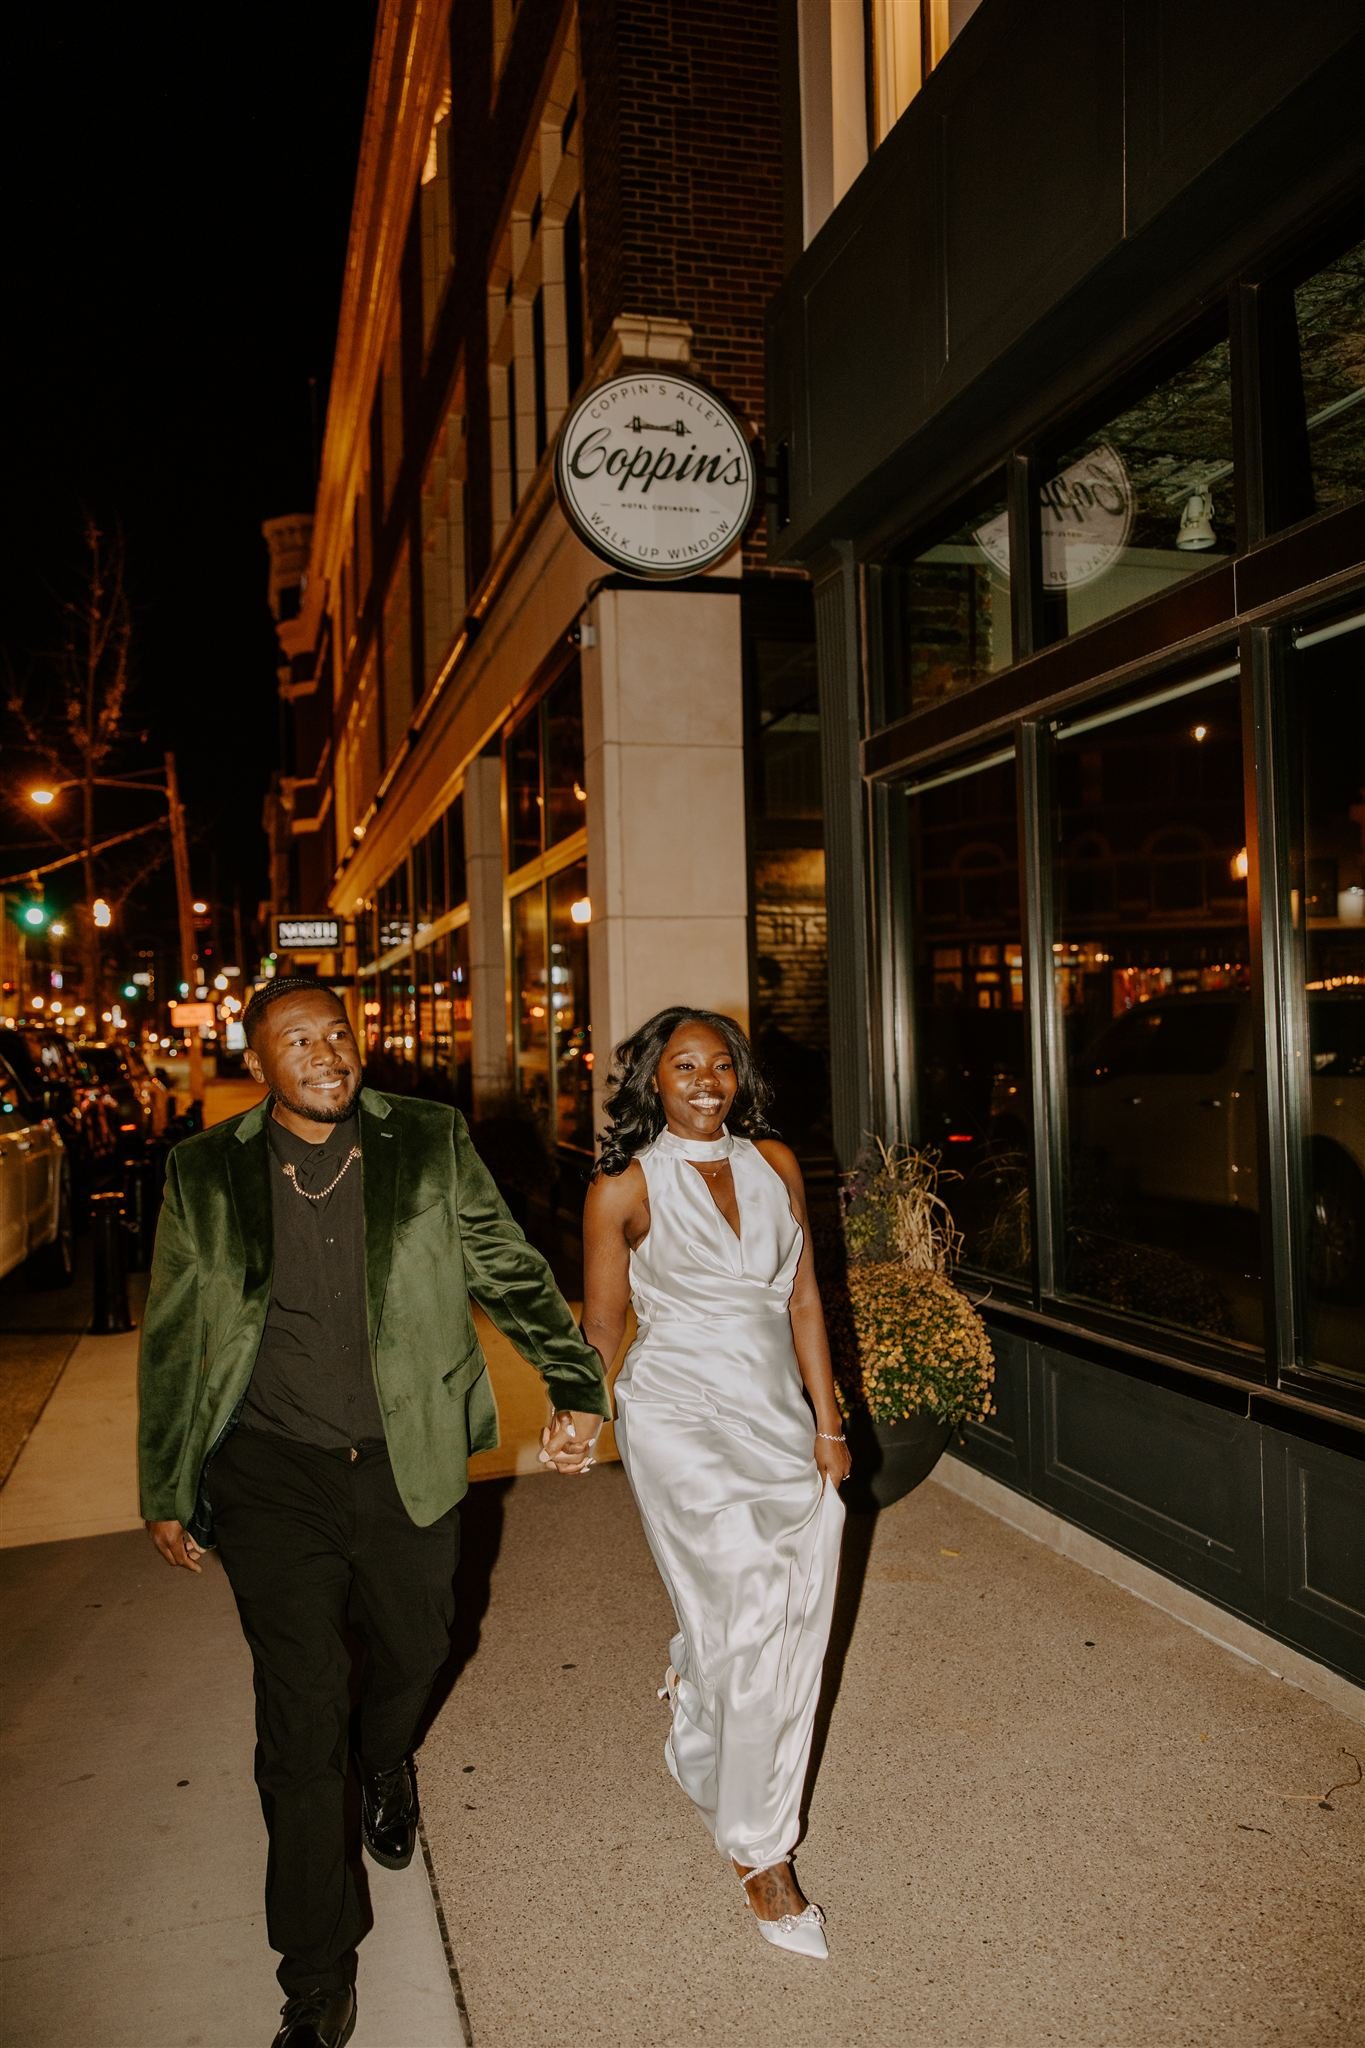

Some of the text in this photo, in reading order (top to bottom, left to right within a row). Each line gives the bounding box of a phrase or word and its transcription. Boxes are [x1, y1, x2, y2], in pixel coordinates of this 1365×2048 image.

[590, 383, 724, 430] COPPIN'S ALLEY
[569, 426, 748, 493] Coppin's
[621, 502, 700, 514] HOTEL COVINGTON
[590, 511, 730, 560] WALK UP WINDOW
